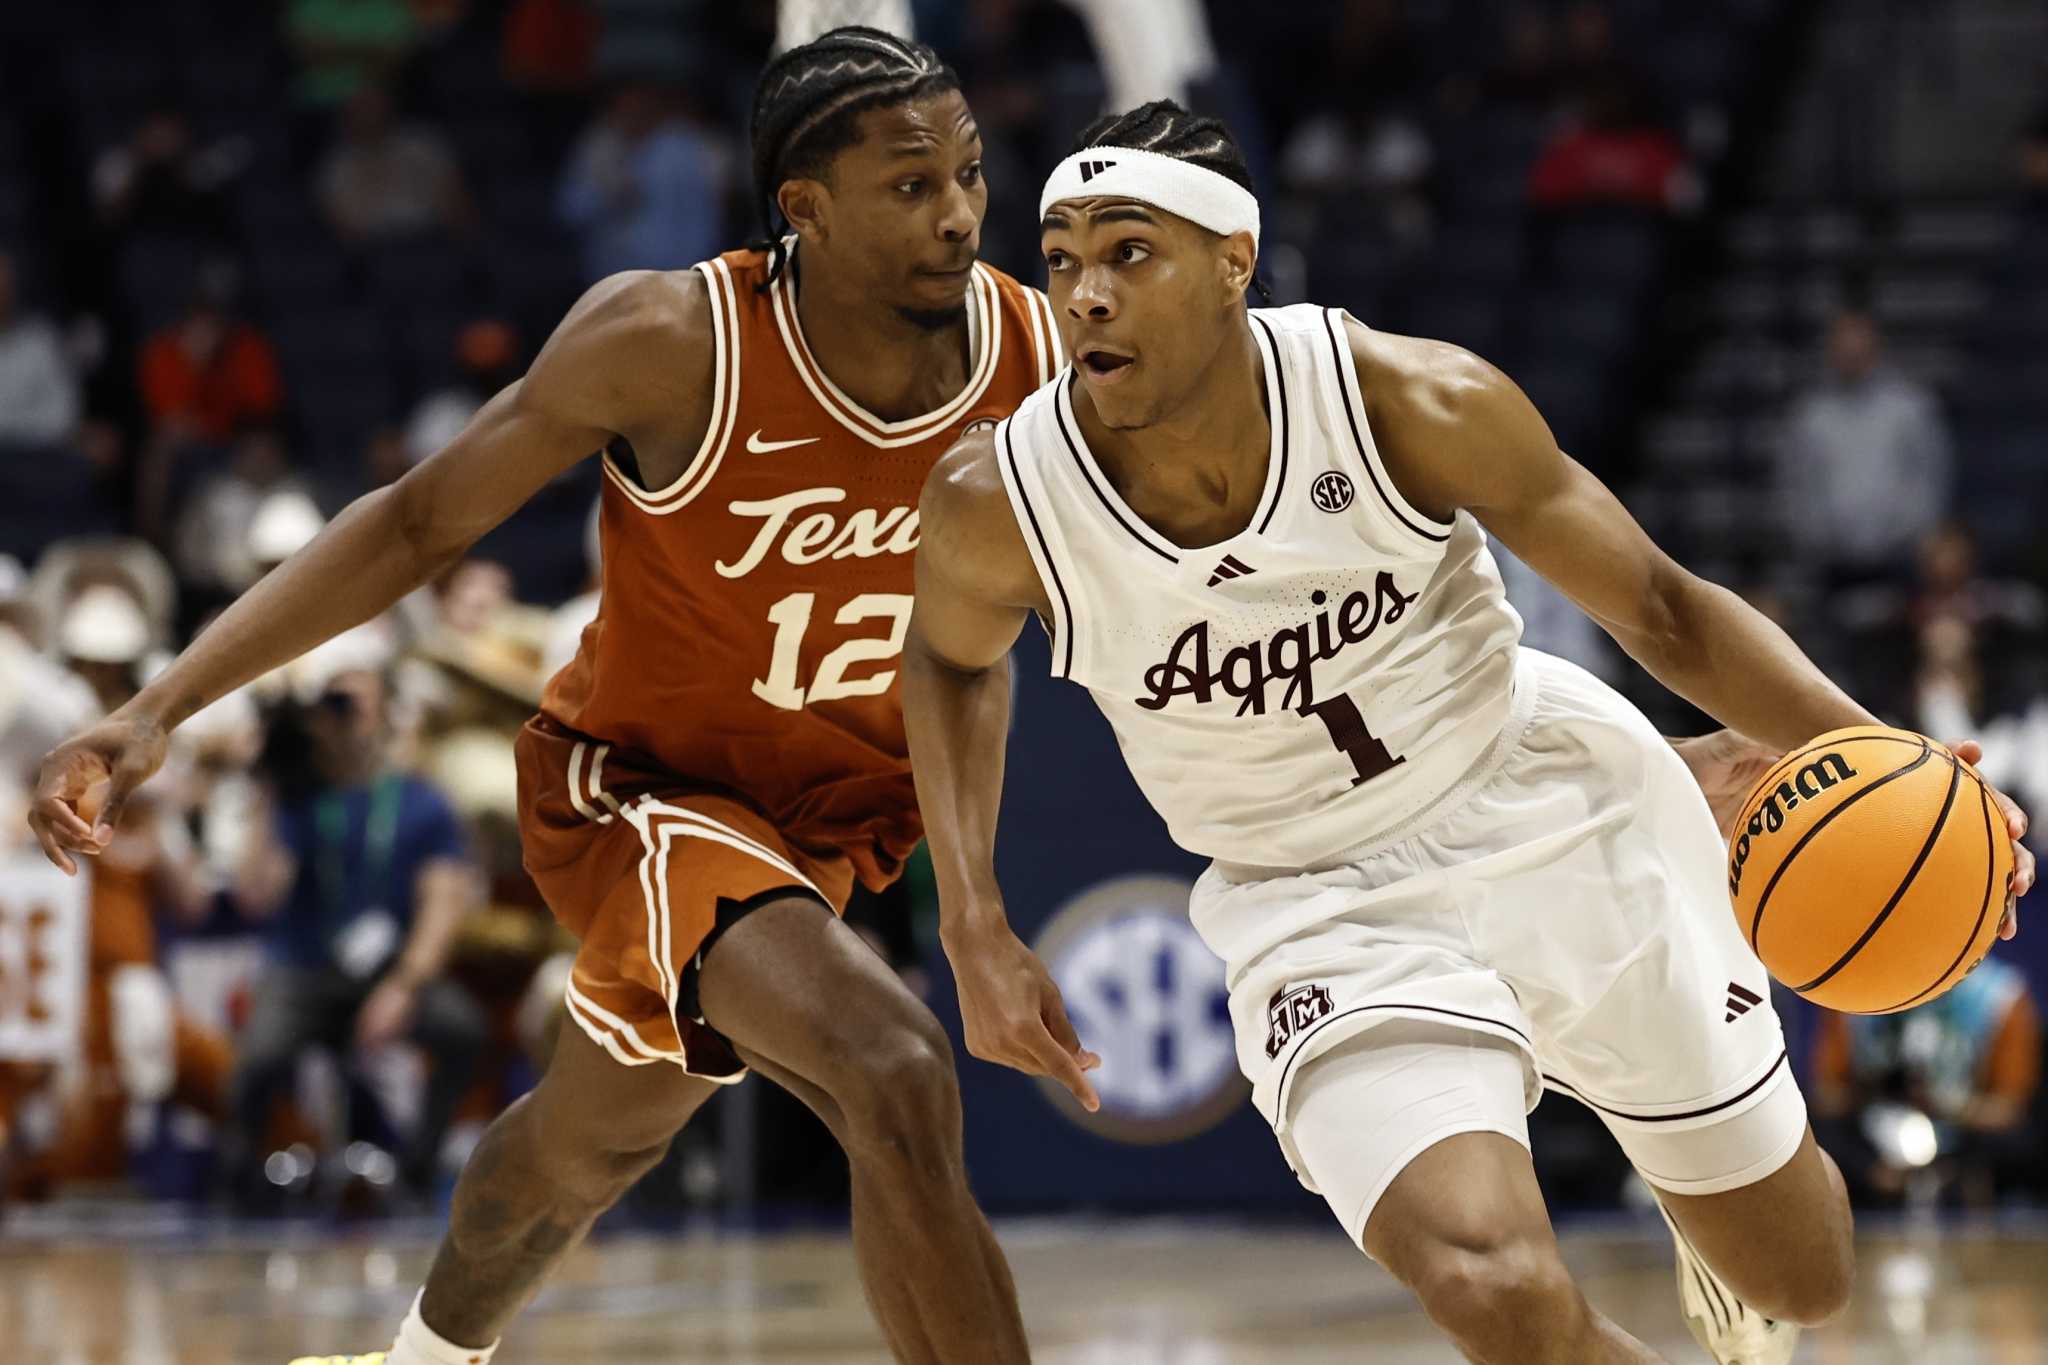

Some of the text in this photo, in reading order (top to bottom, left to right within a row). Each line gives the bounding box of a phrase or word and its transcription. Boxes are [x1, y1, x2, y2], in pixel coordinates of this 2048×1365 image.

[715, 487, 920, 578] Texa
[1315, 475, 1350, 509] SEC
[752, 593, 915, 711] 12
[1134, 571, 1420, 717] Aggies
[1295, 692, 1406, 787] 1
[1729, 753, 1858, 897] Wilson
